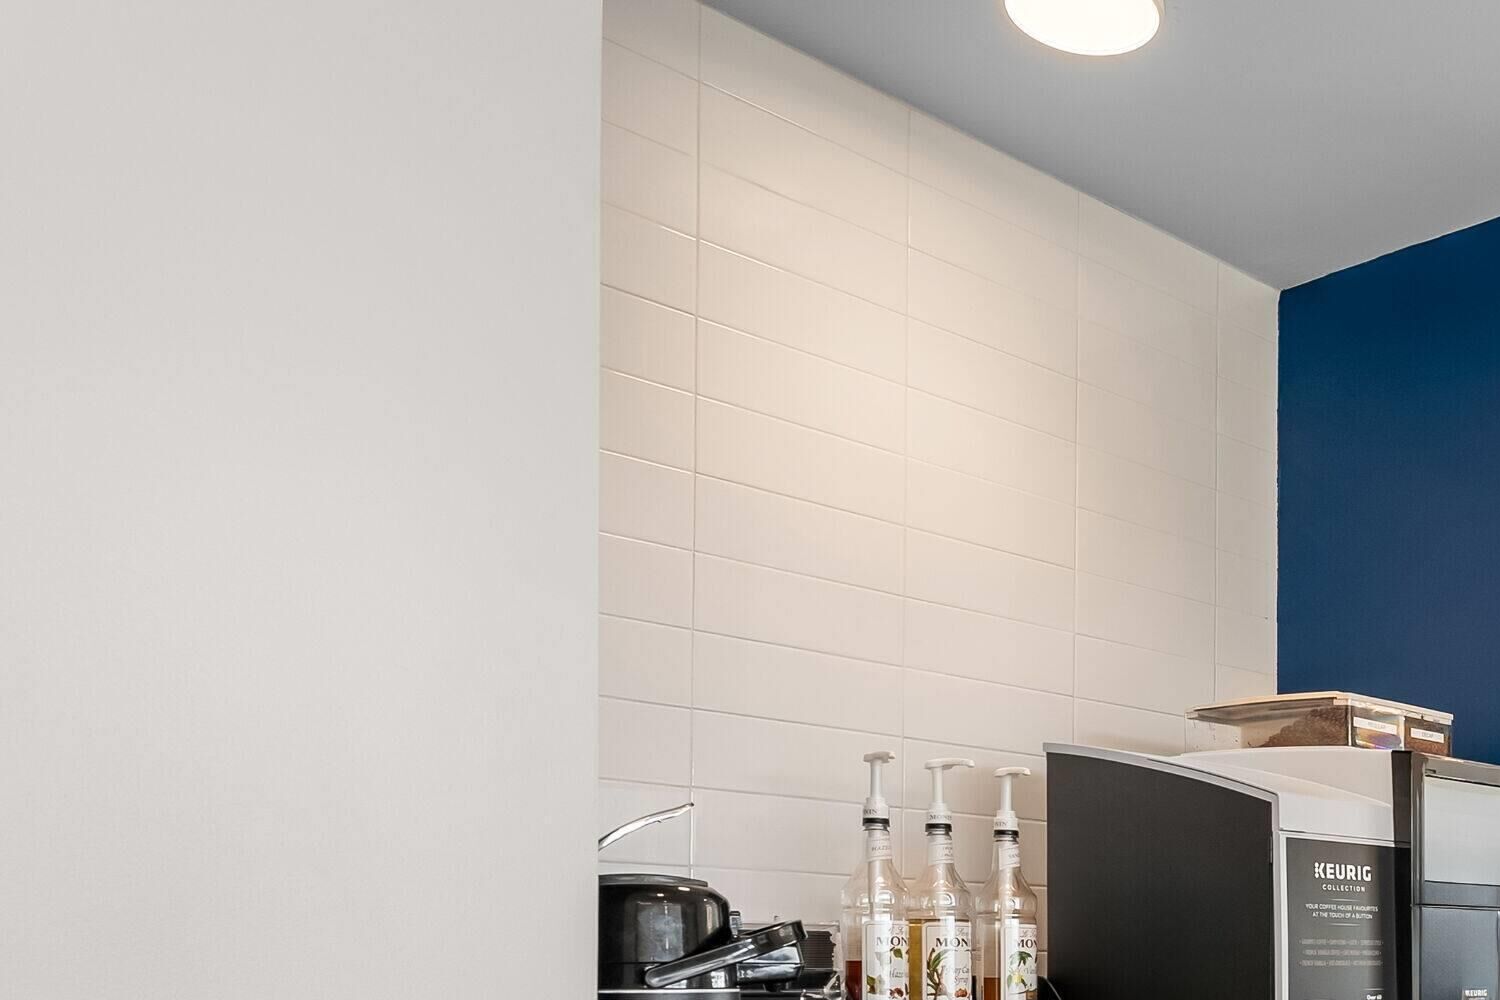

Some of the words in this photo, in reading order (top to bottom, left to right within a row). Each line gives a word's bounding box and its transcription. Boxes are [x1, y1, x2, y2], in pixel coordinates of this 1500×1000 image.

[1314, 861, 1372, 882] KEURIG
[1322, 883, 1366, 893] COLLECTION
[1319, 903, 1337, 911] COFFEE
[1465, 989, 1488, 997] KEURIG
